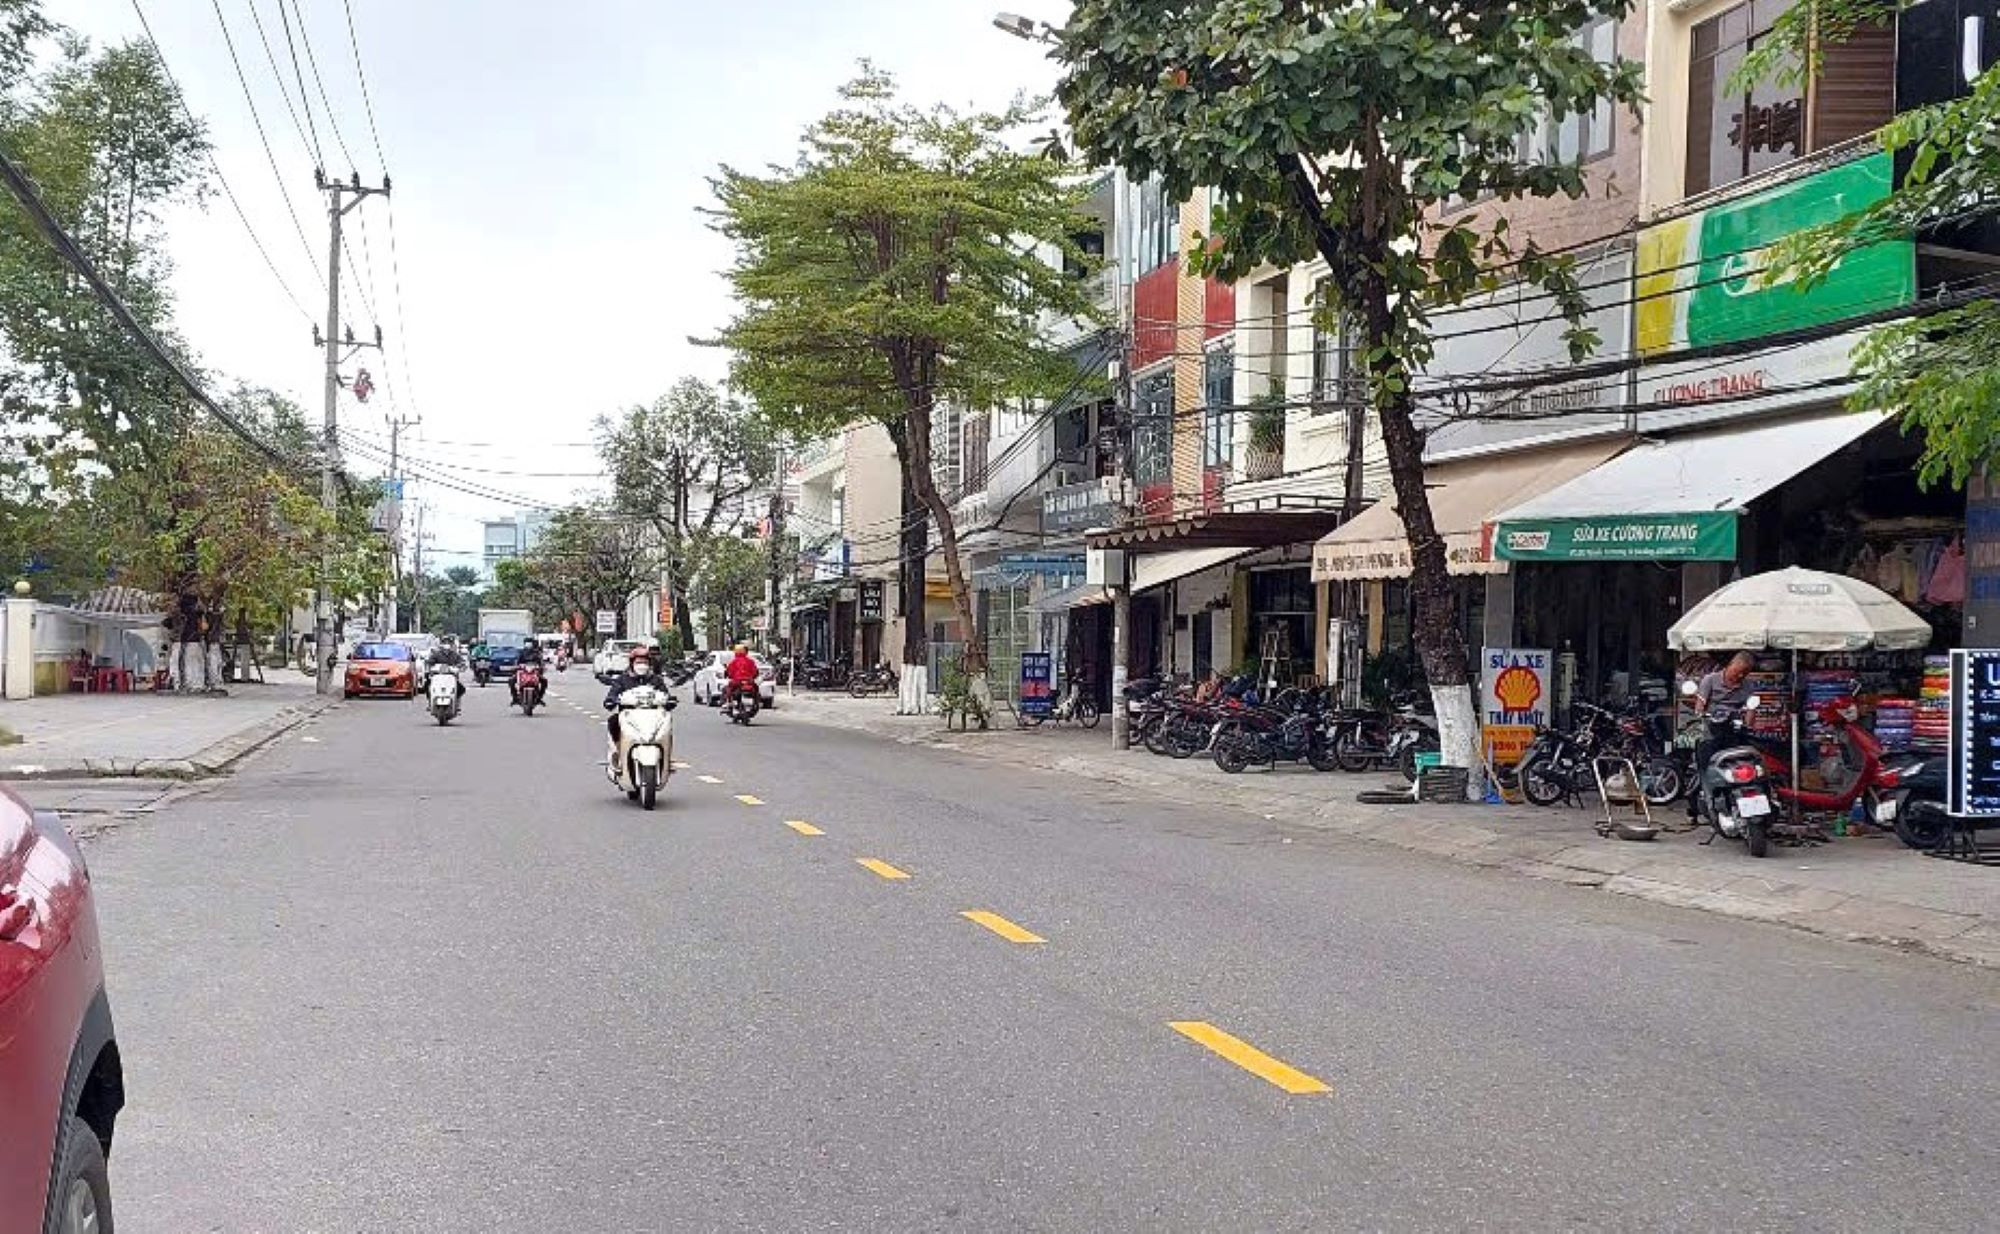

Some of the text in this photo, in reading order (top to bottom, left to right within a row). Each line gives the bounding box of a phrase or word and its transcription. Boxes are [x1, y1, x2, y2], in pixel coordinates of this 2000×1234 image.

[1708, 370, 1763, 397] TRANG
[1572, 522, 1594, 541] SỬA
[1595, 526, 1611, 541] XE
[1656, 523, 1698, 541] TRANG
[1524, 654, 1545, 668] XE
